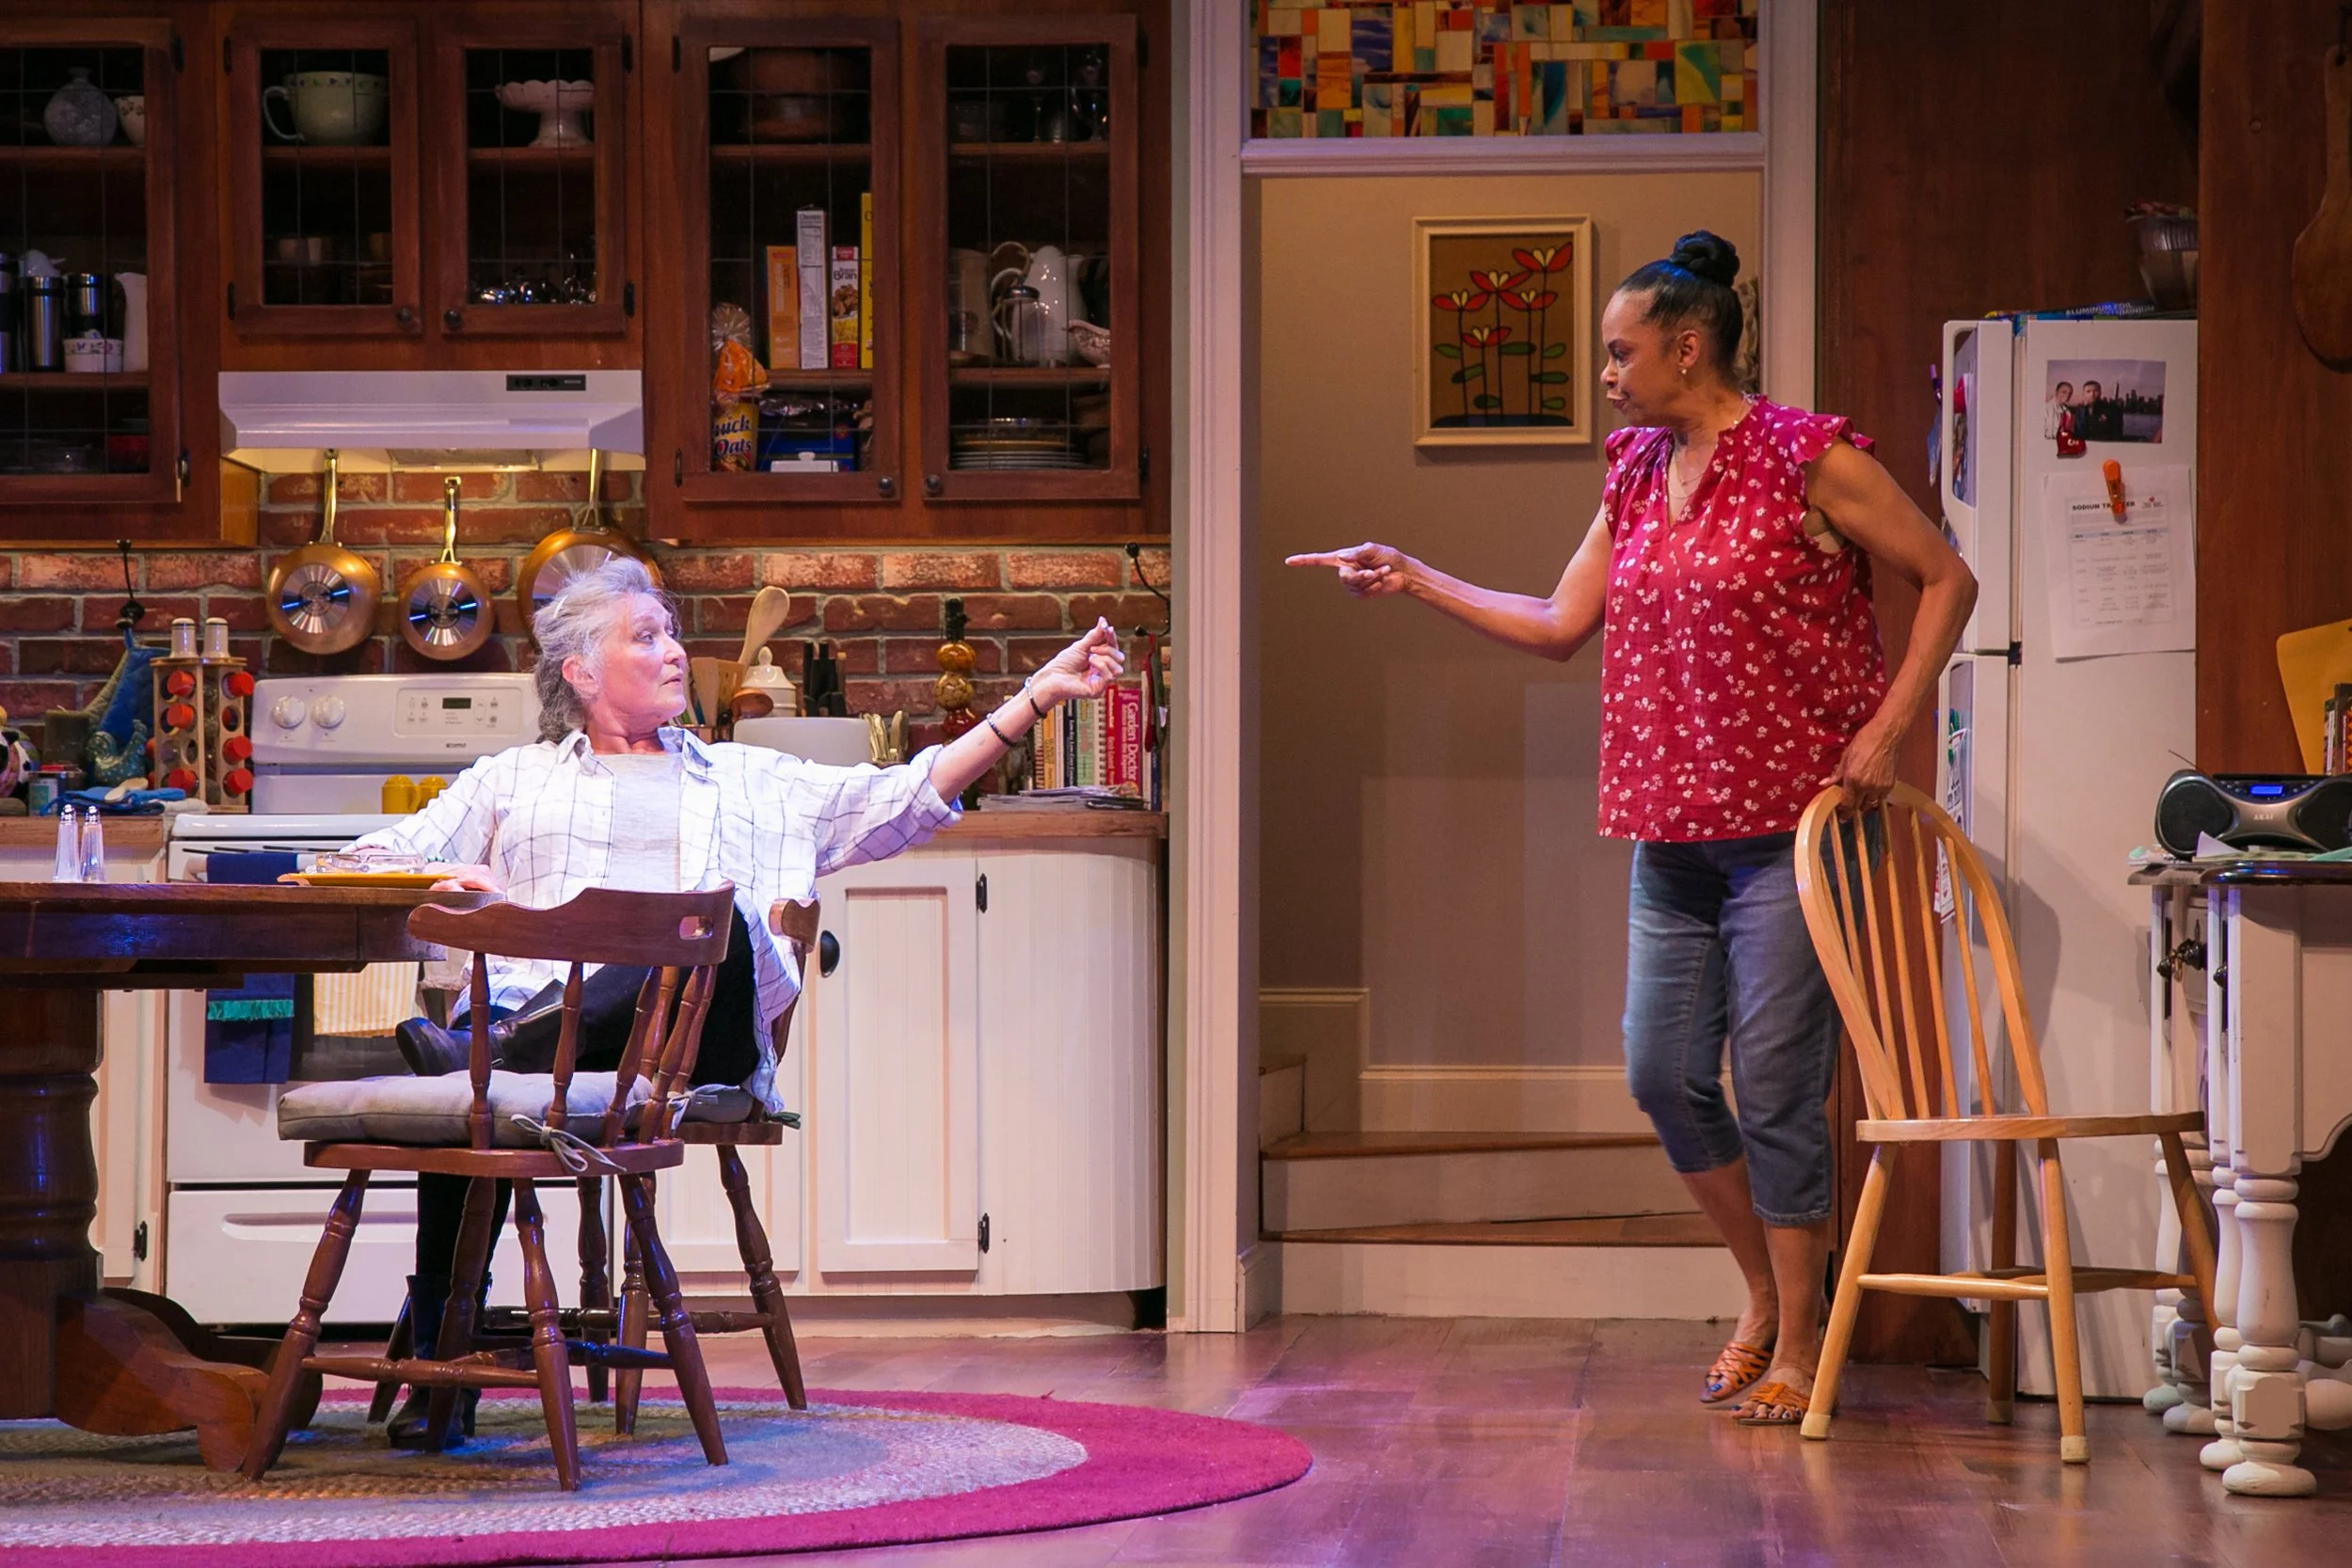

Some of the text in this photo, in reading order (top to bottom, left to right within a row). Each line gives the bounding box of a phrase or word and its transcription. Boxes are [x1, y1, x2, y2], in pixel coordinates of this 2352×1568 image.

[834, 270, 857, 280] Bran
[2065, 304, 2112, 316] ALUMINUM
[712, 414, 751, 436] uick
[714, 438, 752, 457] Oats
[2102, 500, 2136, 509] TRER
[1127, 702, 1139, 741] Garden
[1127, 743, 1139, 781] Doctor
